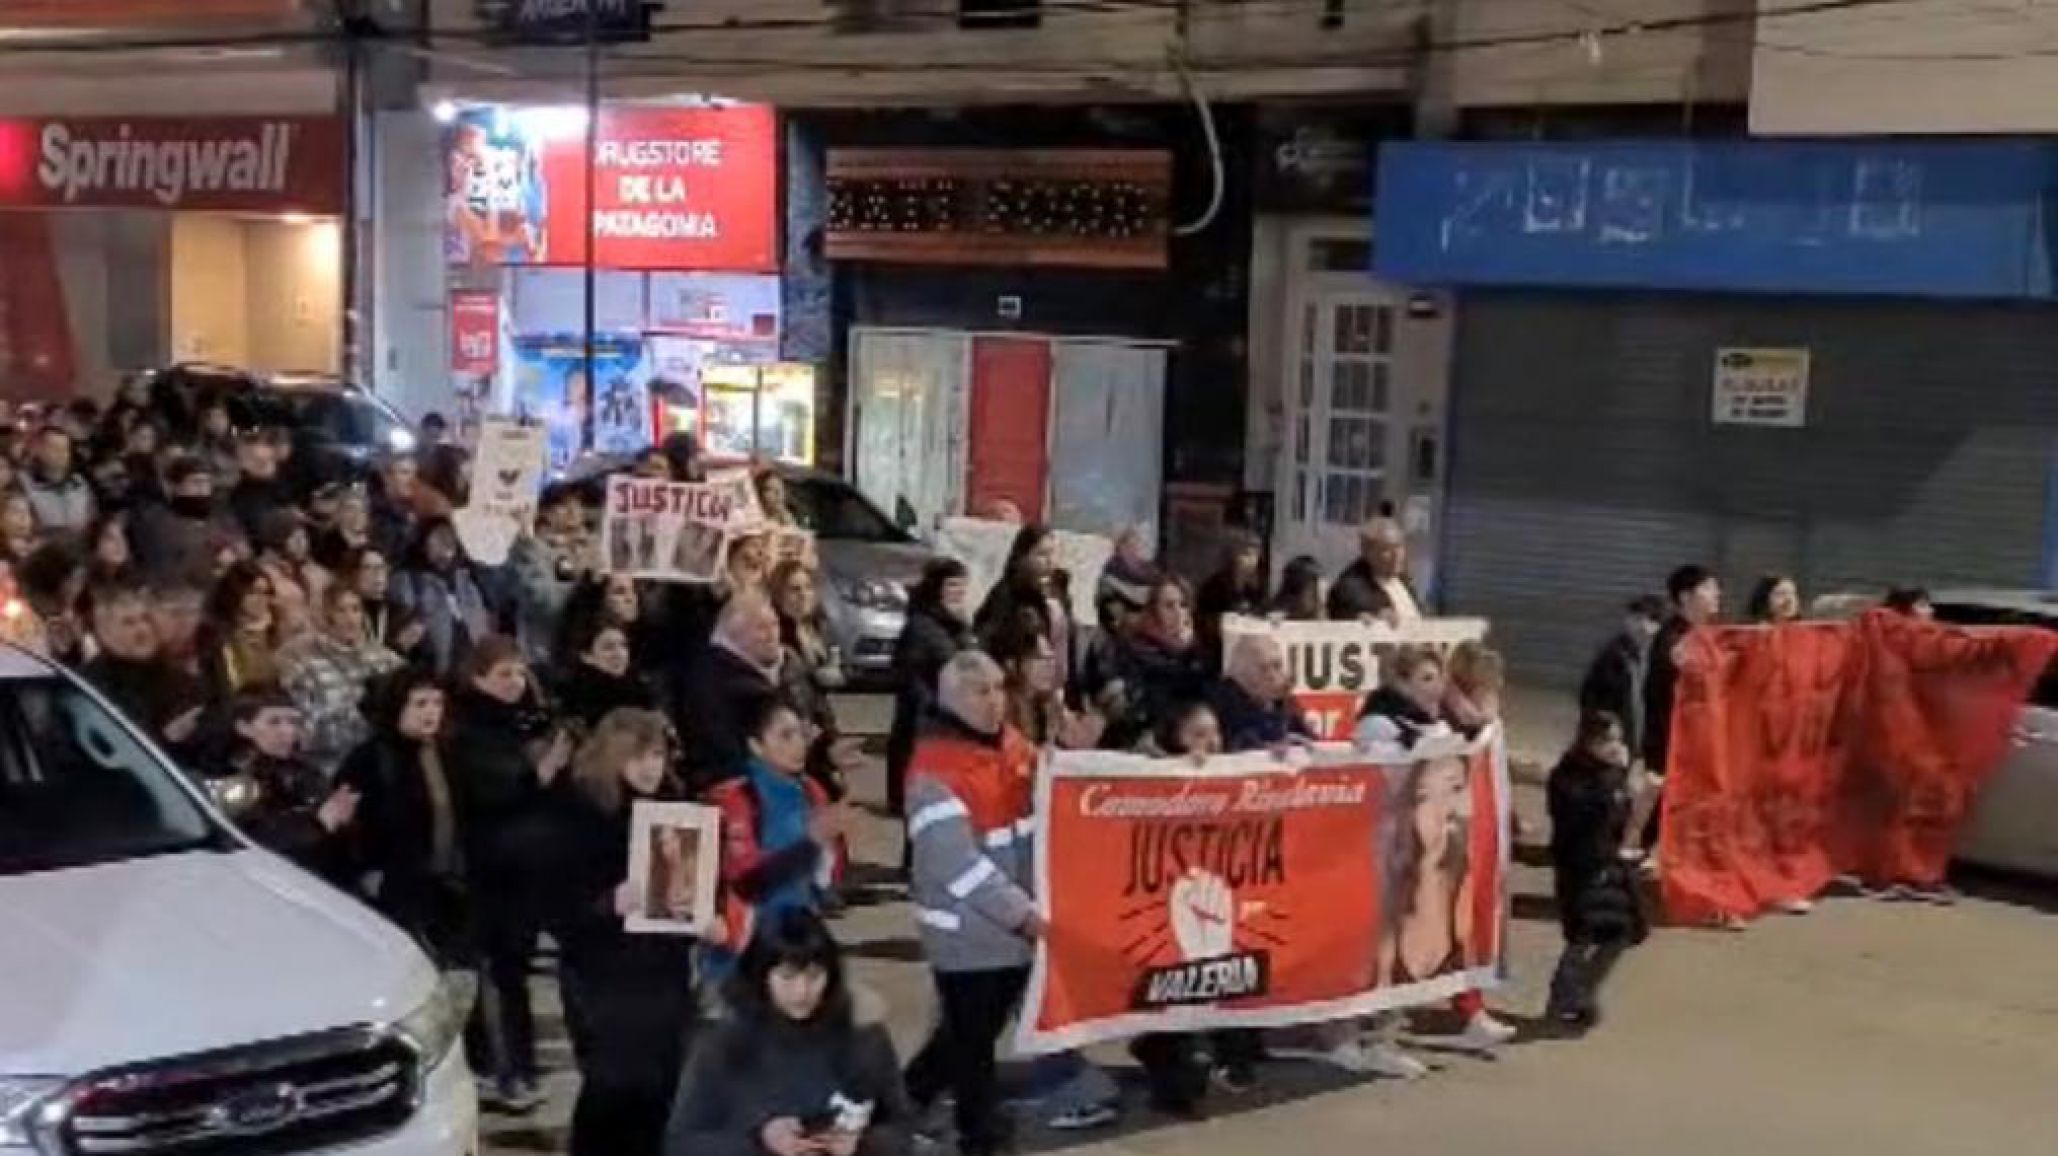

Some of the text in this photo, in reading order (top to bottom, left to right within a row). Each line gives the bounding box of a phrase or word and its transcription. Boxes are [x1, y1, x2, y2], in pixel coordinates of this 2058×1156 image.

[38, 123, 289, 203] Springwall
[594, 138, 722, 167] RUGSTORE
[618, 175, 687, 202] DE LA
[1287, 641, 1450, 690] JUST
[1121, 812, 1286, 897] JUSTICIA
